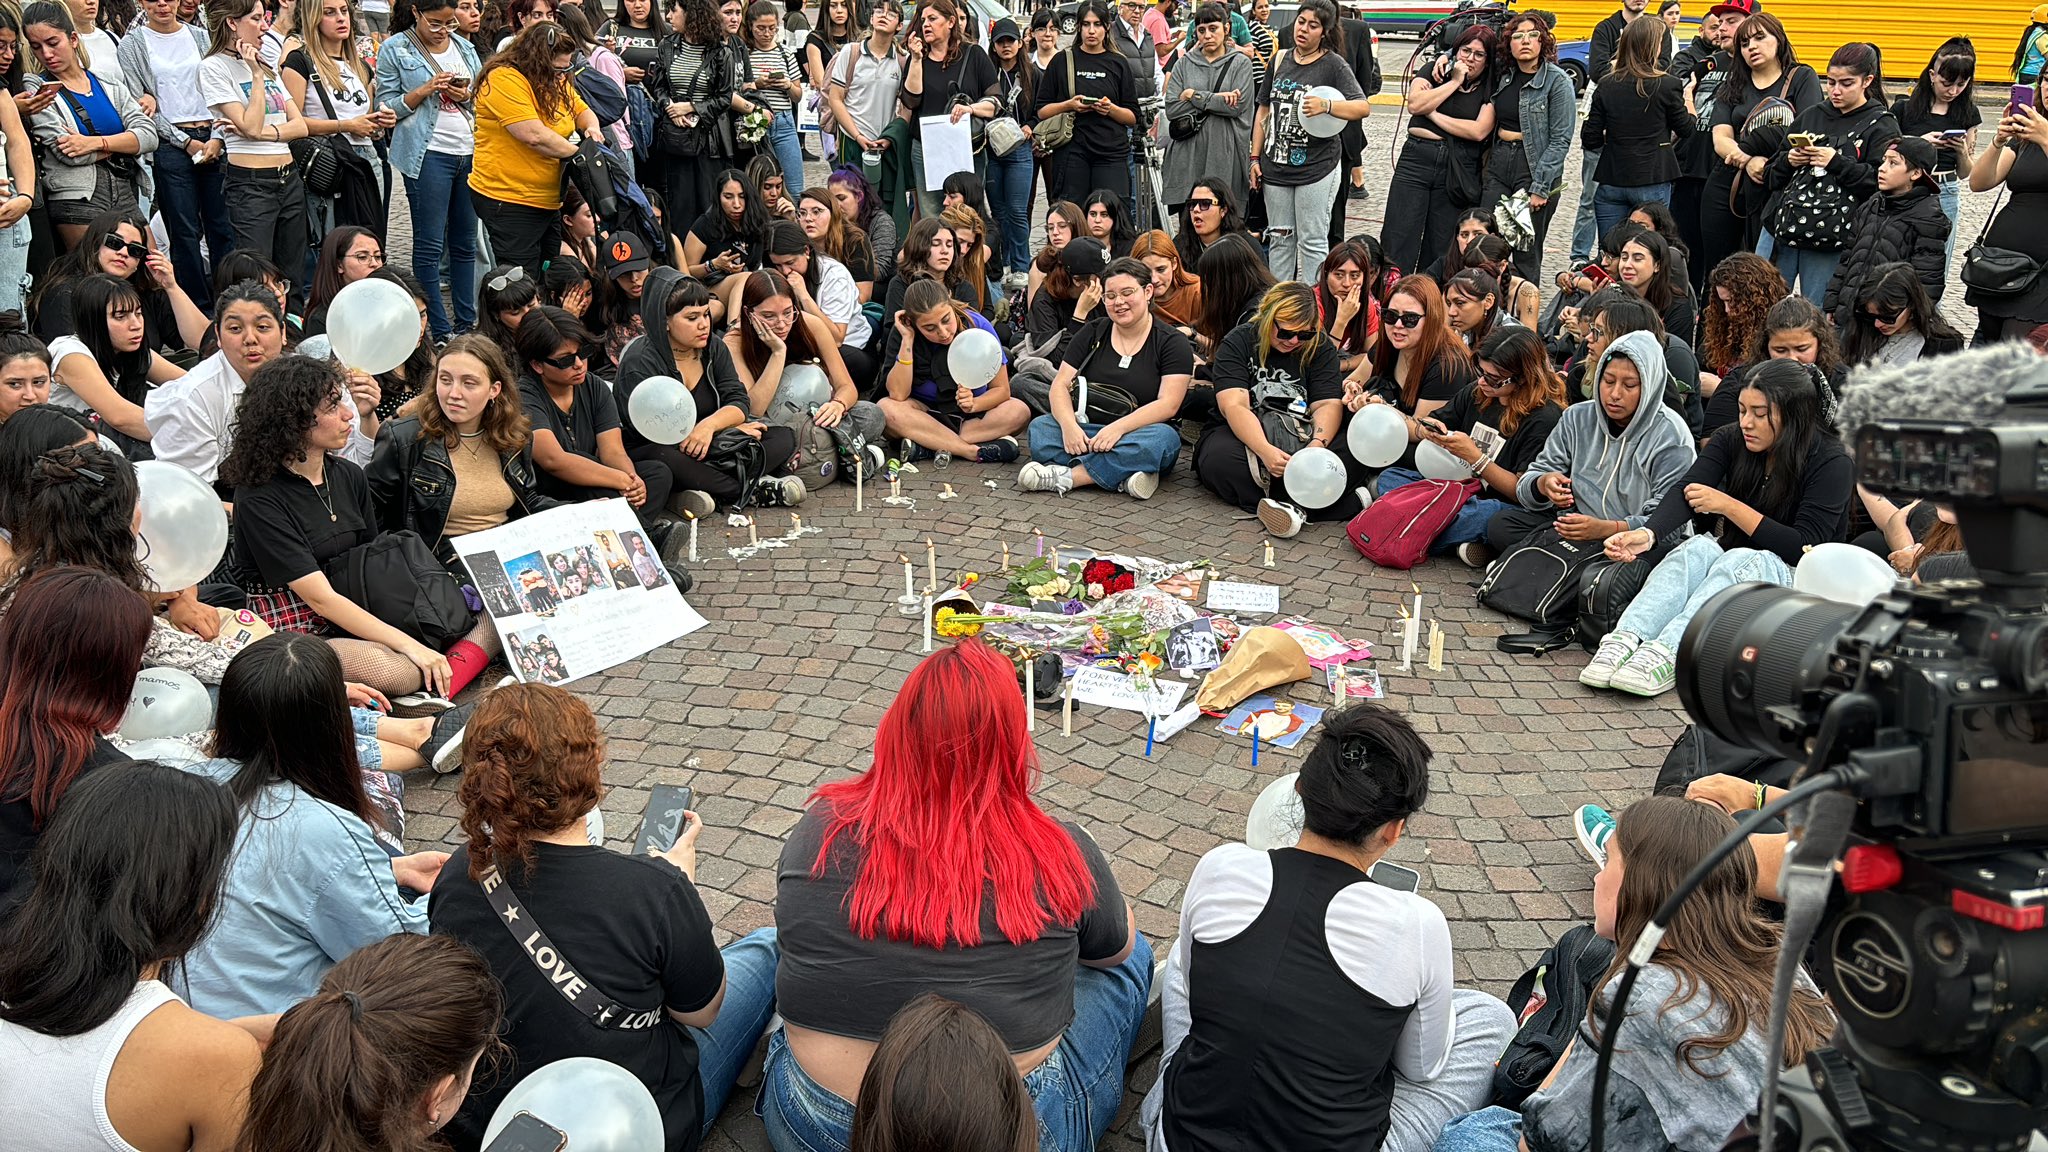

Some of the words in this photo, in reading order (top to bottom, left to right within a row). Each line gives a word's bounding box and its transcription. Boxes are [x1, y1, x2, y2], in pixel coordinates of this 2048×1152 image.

[138, 676, 181, 690] mamos
[1078, 679, 1120, 690] HEARTS
[523, 931, 587, 1000] LOVE
